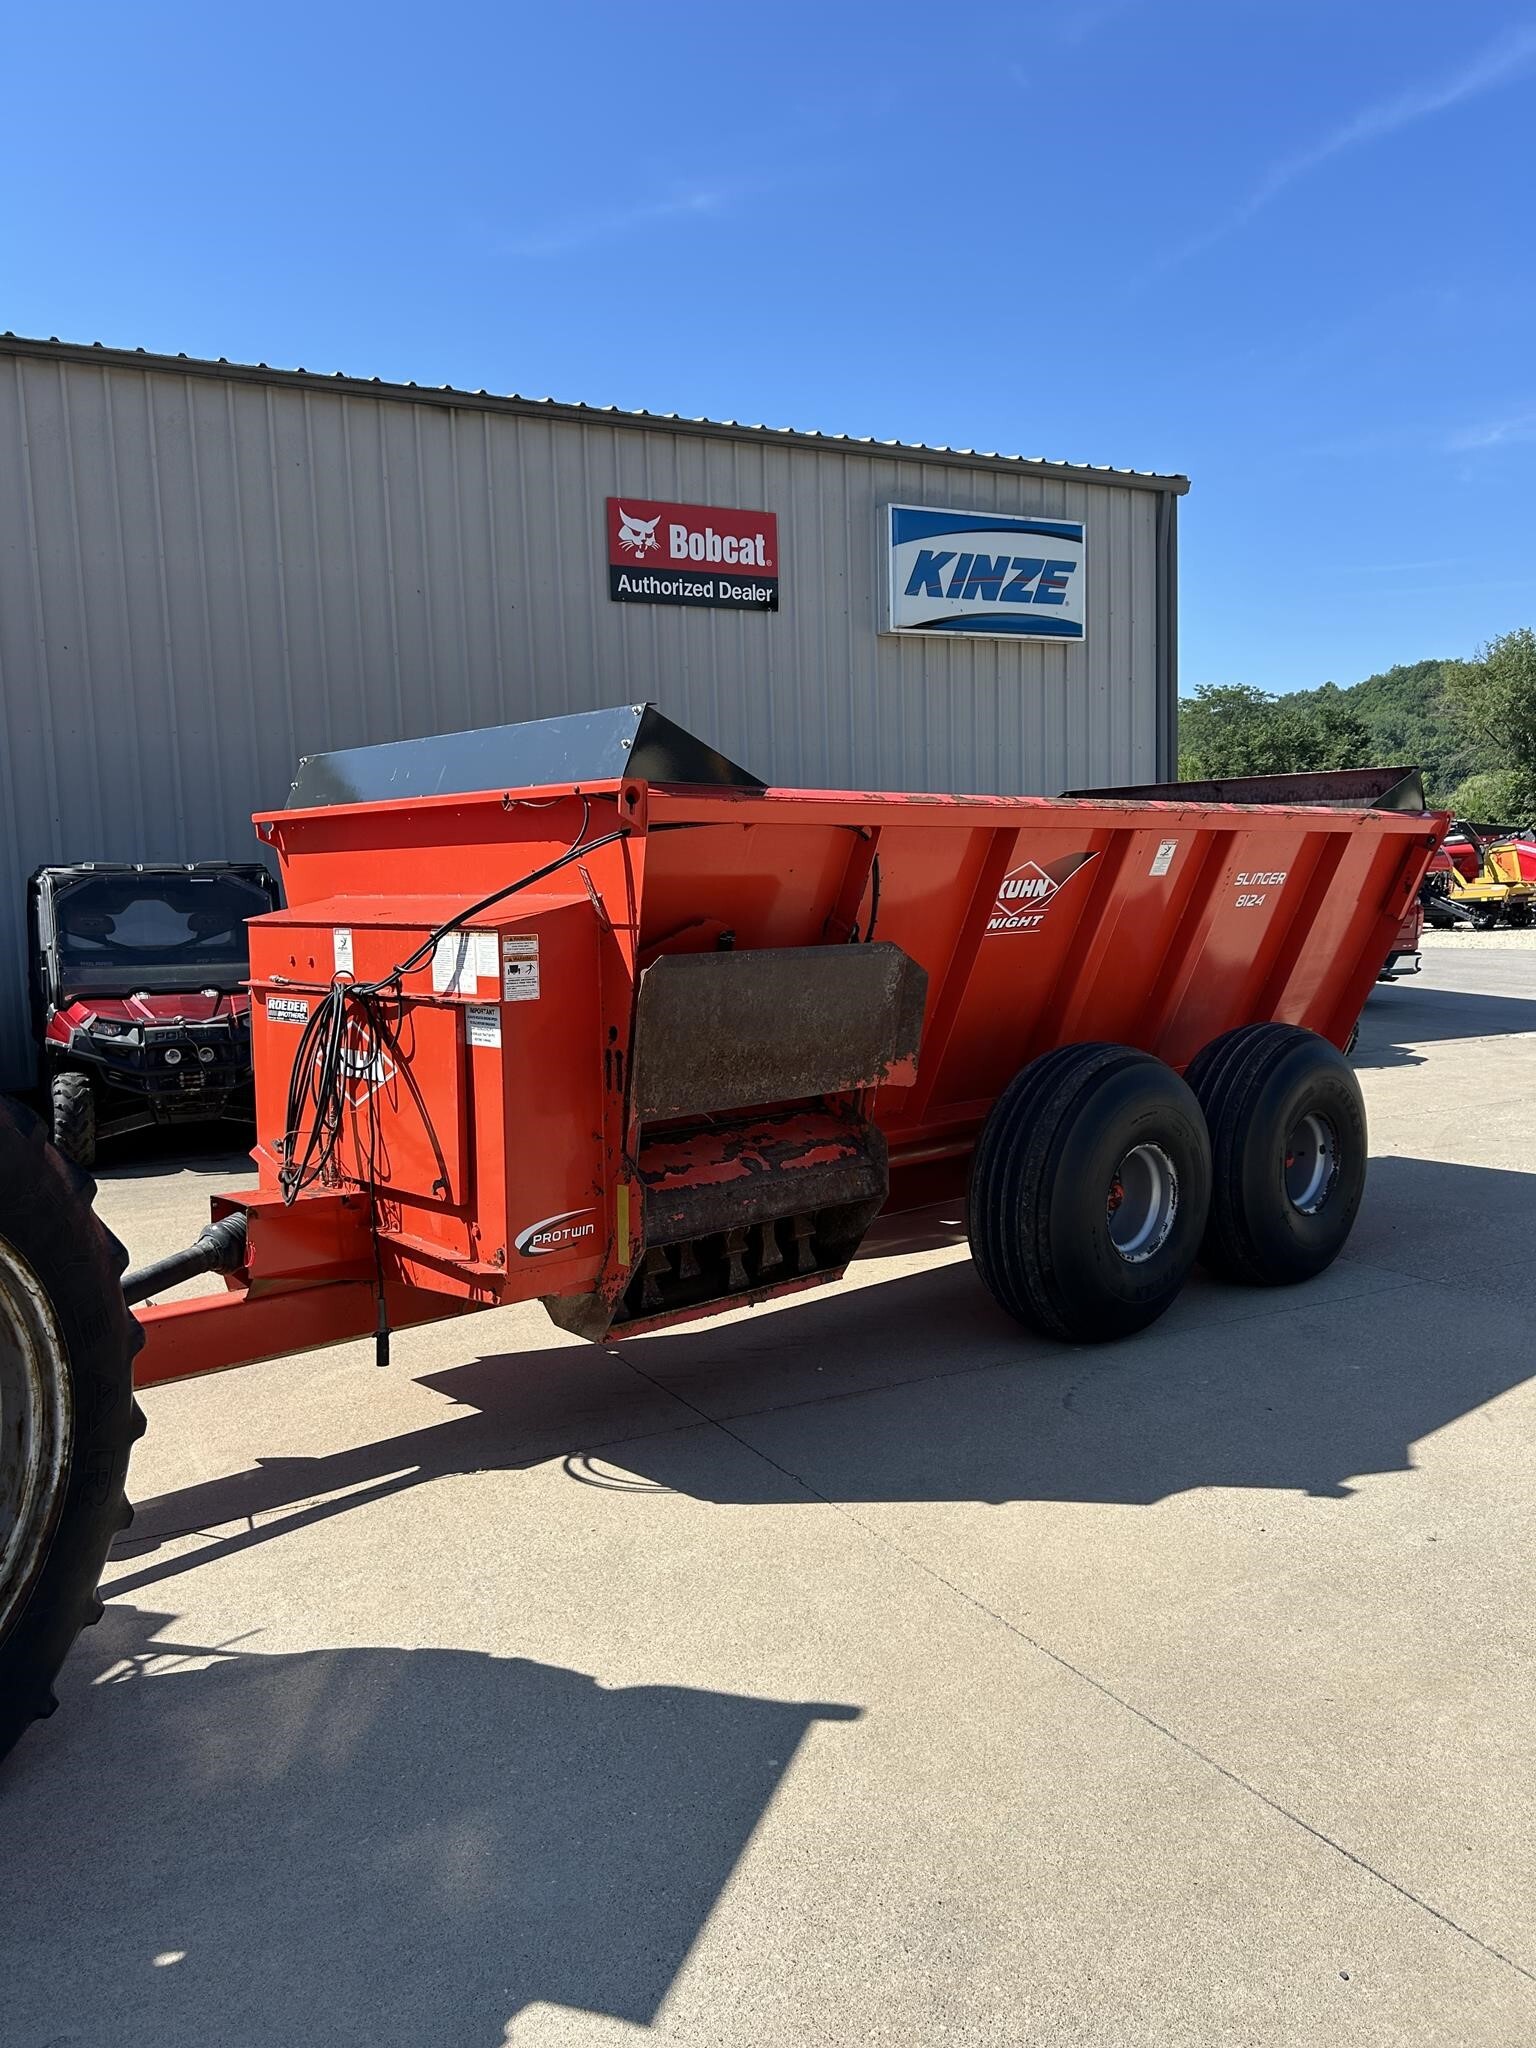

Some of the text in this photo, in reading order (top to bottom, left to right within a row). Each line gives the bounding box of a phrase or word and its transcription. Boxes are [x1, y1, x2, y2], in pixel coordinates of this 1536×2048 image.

[669, 523, 766, 567] Bobcat
[904, 549, 1078, 606] KINZE
[617, 574, 773, 602] Authorized Dealer
[1233, 872, 1288, 886] SLINGER
[1235, 893, 1267, 907] 8124
[986, 914, 1045, 930] NIGHT
[268, 999, 308, 1013] ROEDER
[277, 1010, 306, 1020] BROTHERS
[532, 1223, 595, 1246] PROTWIN
